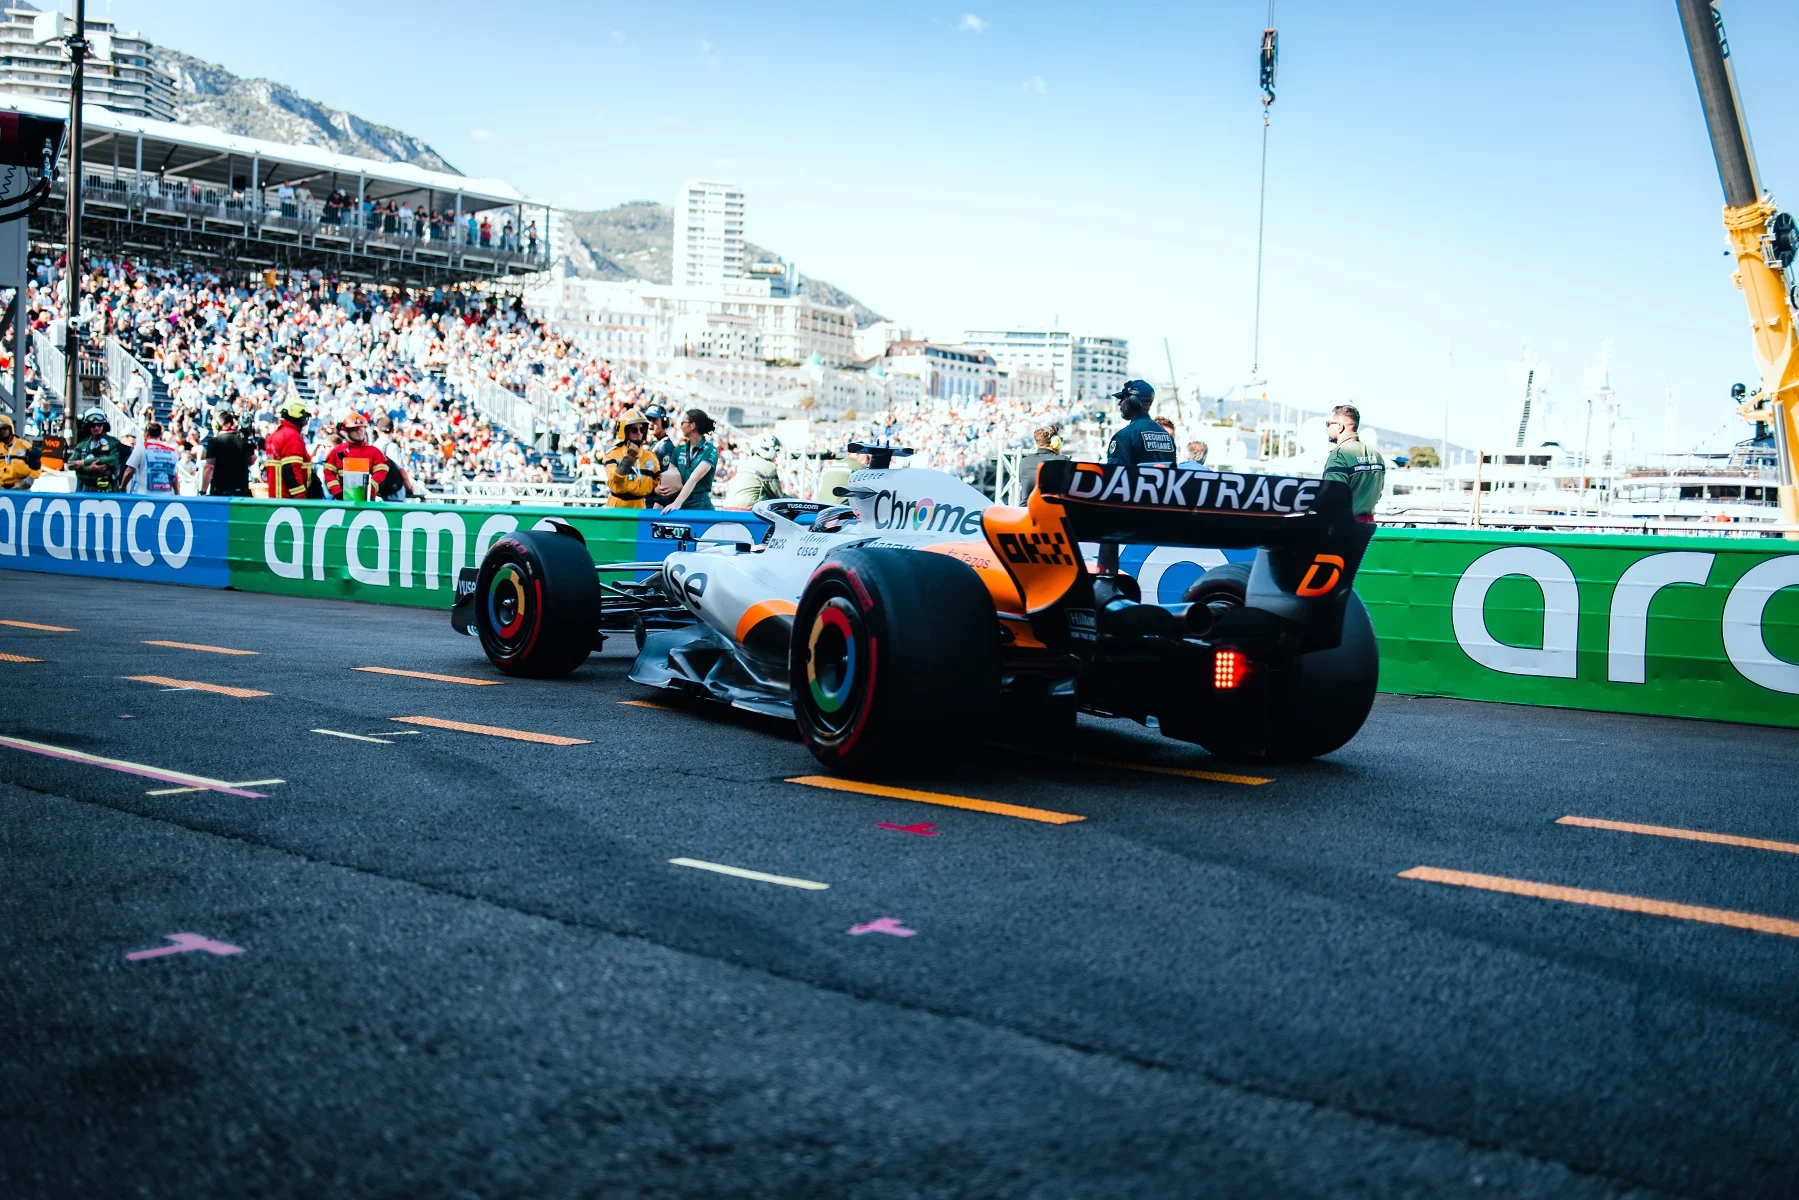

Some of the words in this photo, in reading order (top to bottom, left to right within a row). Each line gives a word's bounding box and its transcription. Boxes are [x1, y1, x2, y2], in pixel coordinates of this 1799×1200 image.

[1709, 0, 1731, 59] ACO
[1068, 463, 1320, 512] DARKTRACE
[874, 489, 982, 536] Chrome
[264, 506, 570, 592] aramc
[997, 532, 1074, 566] OKX
